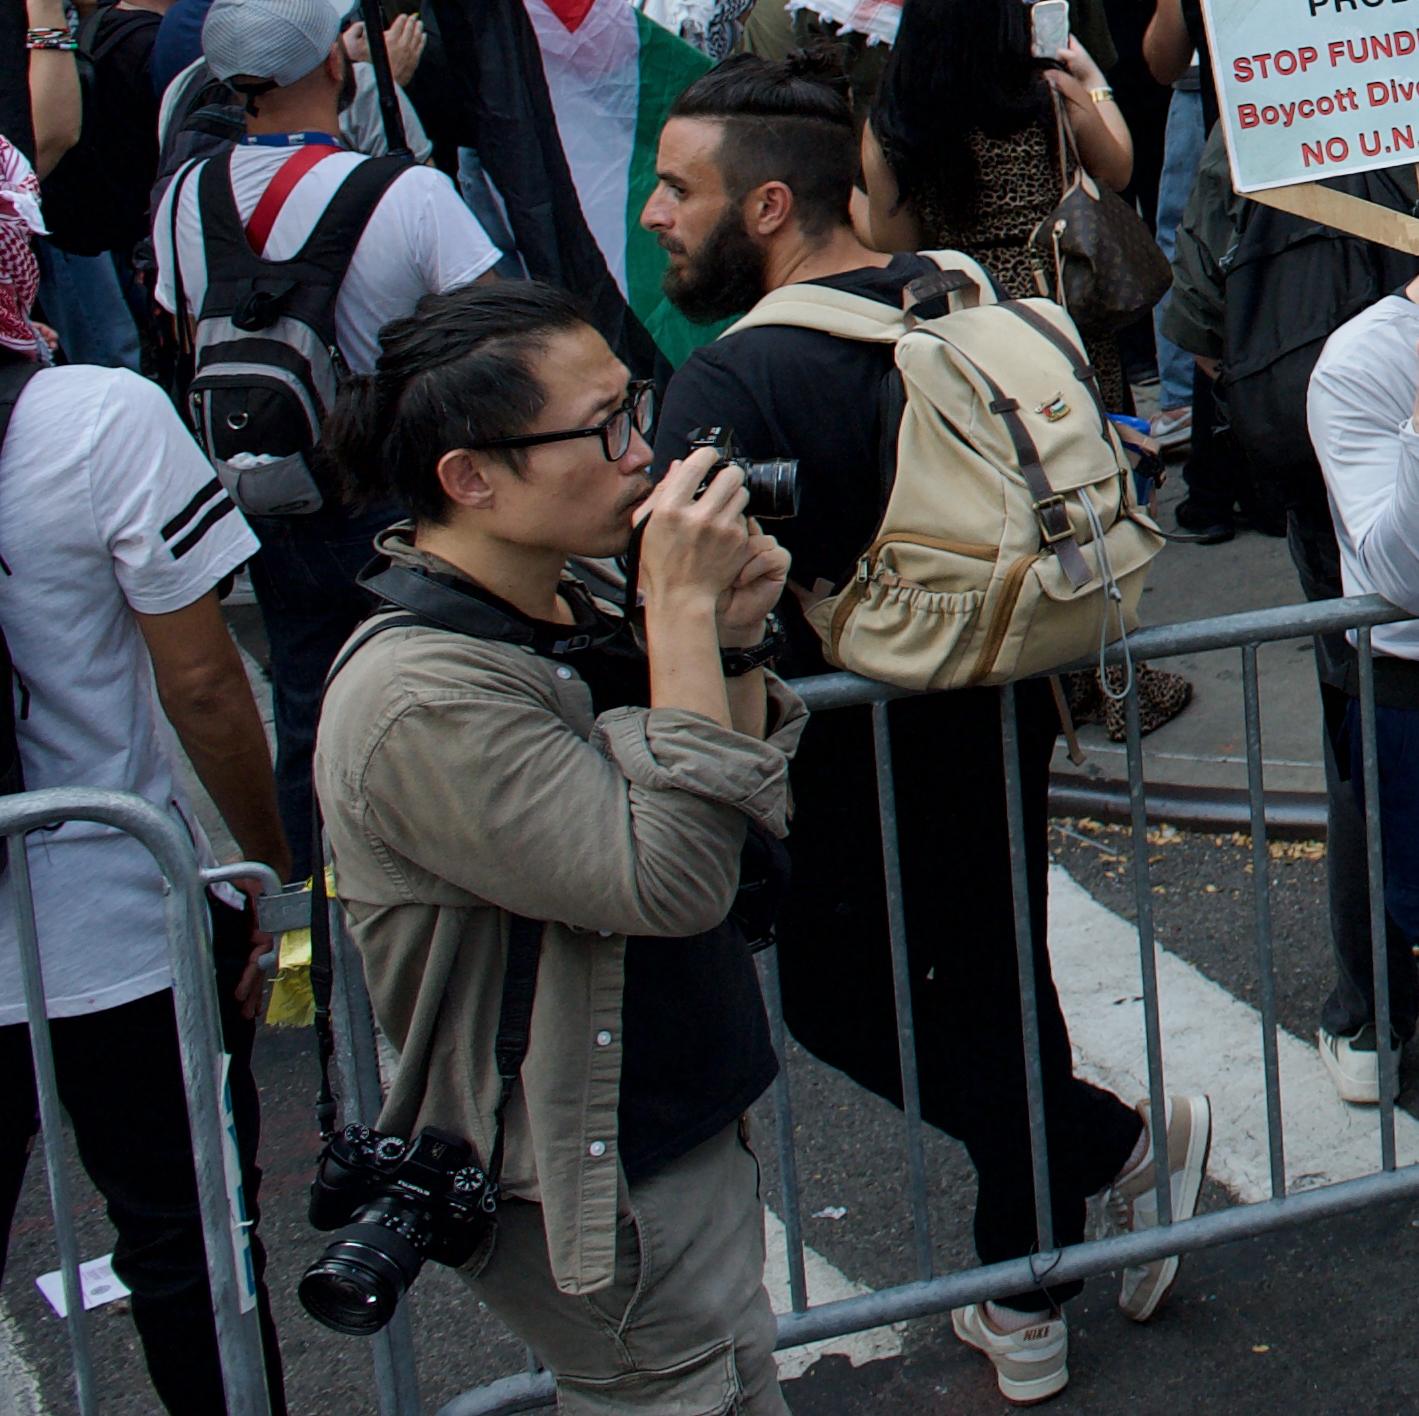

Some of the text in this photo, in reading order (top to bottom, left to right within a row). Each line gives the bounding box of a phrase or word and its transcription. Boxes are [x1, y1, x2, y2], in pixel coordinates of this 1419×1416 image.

[1233, 46, 1319, 83] STOP
[1237, 87, 1359, 129] Boycott
[1301, 137, 1349, 167] NO
